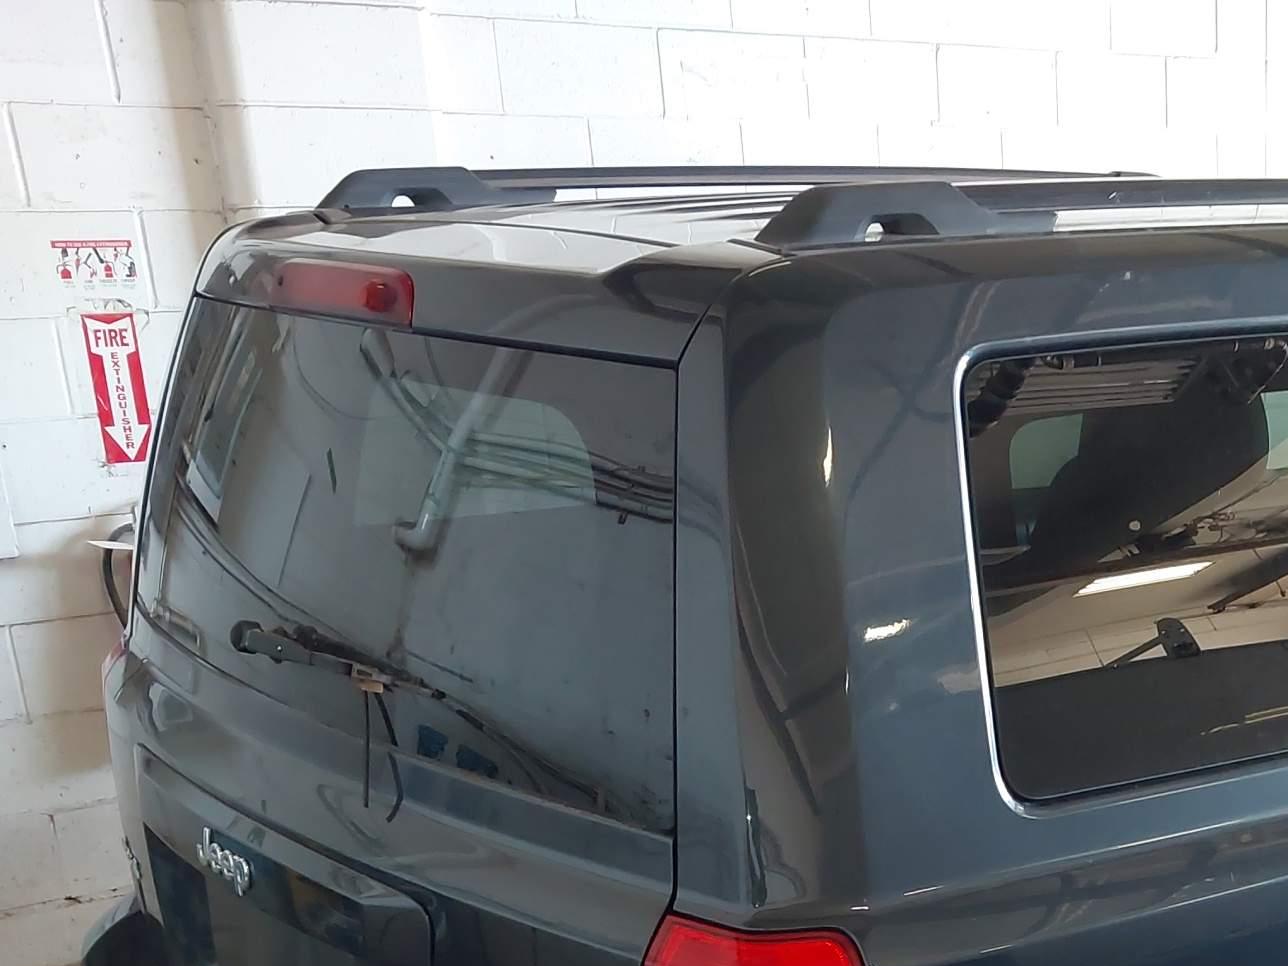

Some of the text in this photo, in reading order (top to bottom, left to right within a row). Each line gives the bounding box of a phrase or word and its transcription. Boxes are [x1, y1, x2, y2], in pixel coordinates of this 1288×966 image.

[93, 327, 130, 348] FIRE
[110, 351, 136, 449] EXTINGUISHER
[196, 826, 250, 897] Jeep
